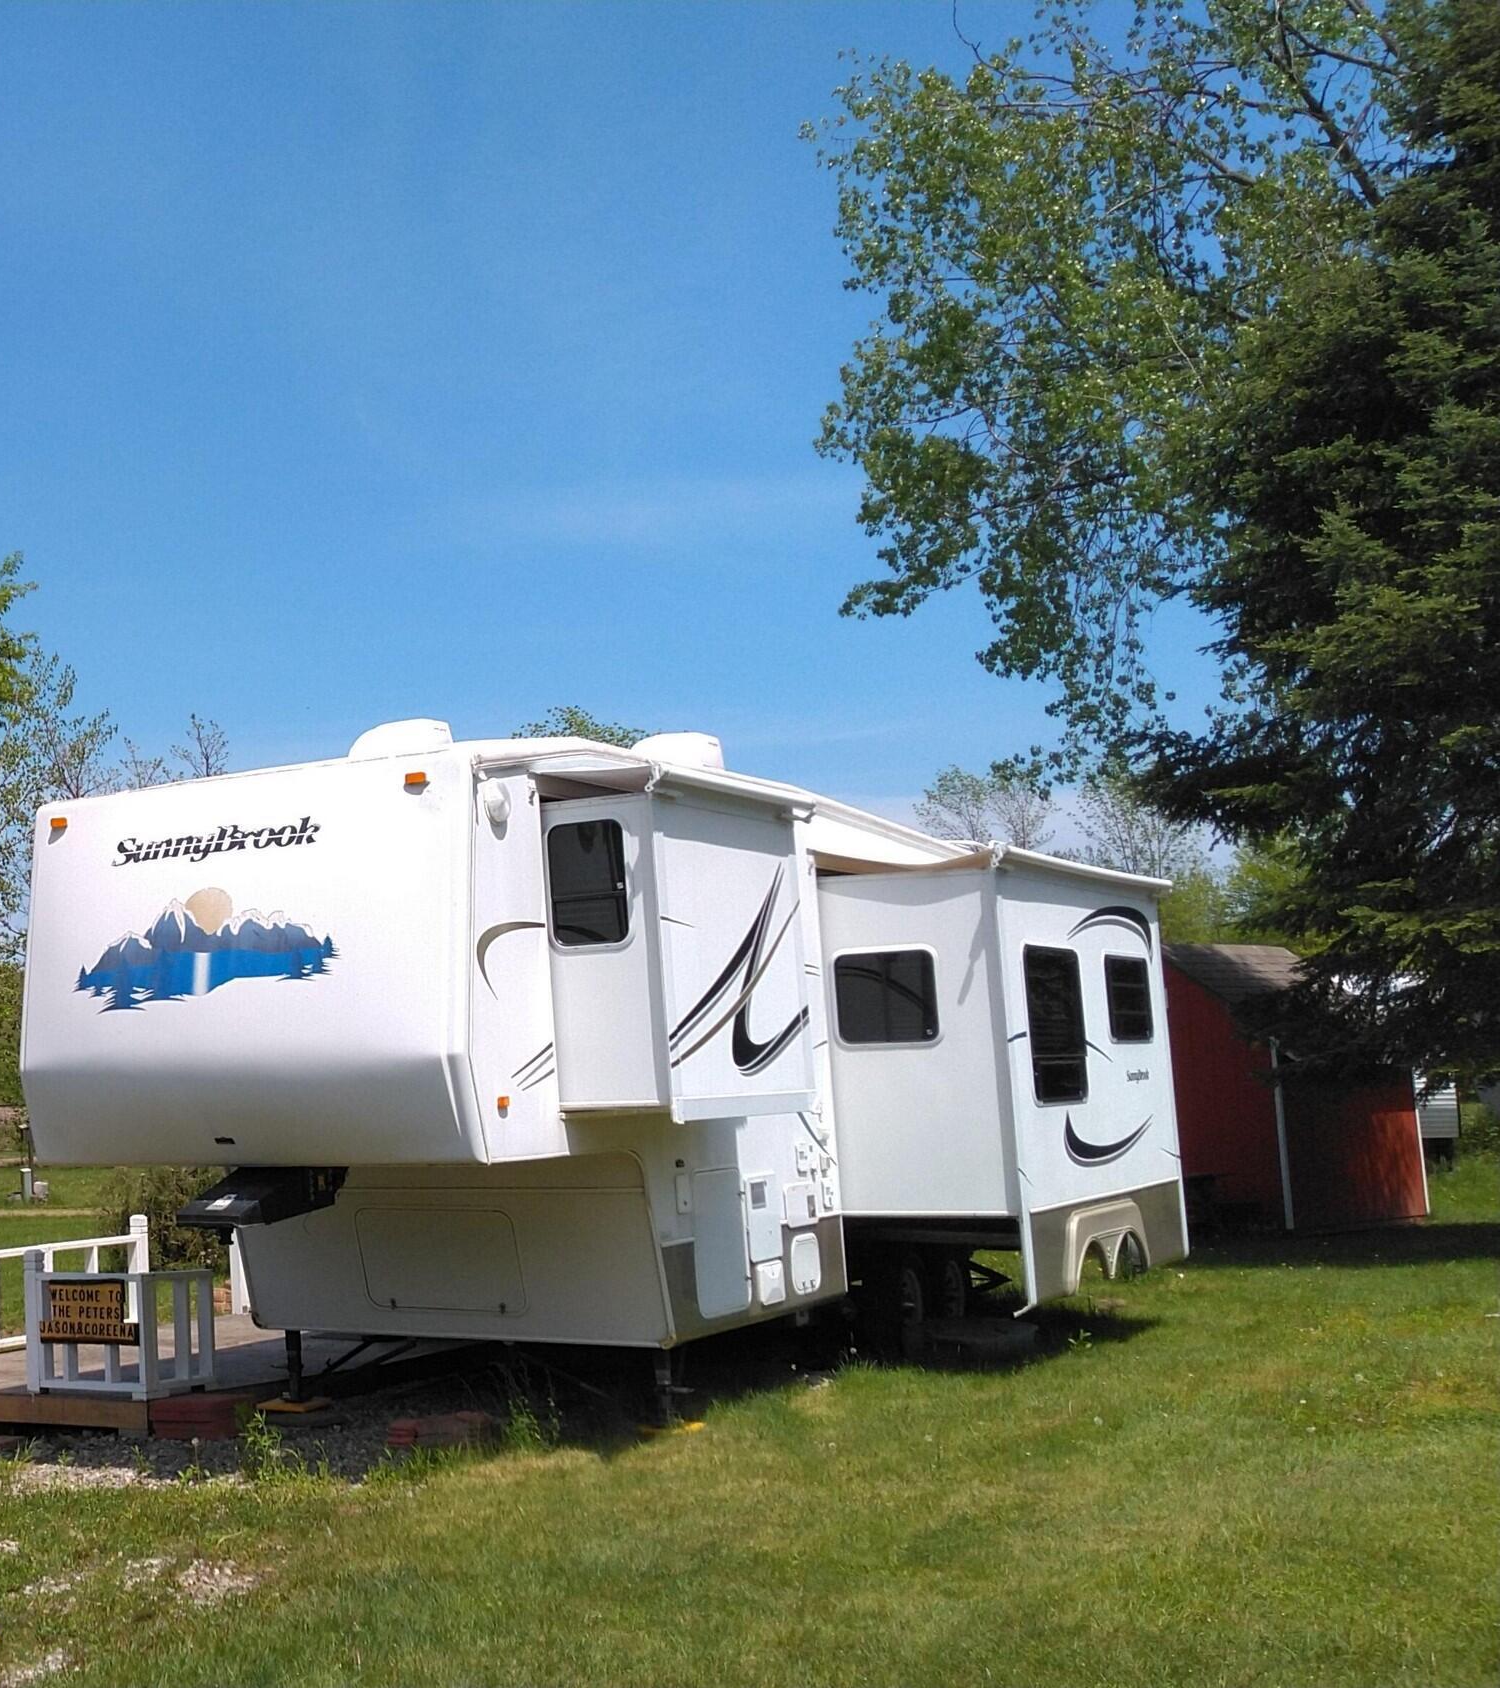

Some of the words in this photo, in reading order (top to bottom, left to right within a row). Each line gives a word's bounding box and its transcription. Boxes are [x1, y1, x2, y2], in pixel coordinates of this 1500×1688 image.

[111, 816, 321, 867] SunnyBrook
[50, 1288, 101, 1302] WELCOME
[108, 1290, 123, 1303] TO
[52, 1305, 71, 1318] THE
[78, 1306, 120, 1320] PETERS
[40, 1321, 134, 1338] JASON&COREENA
